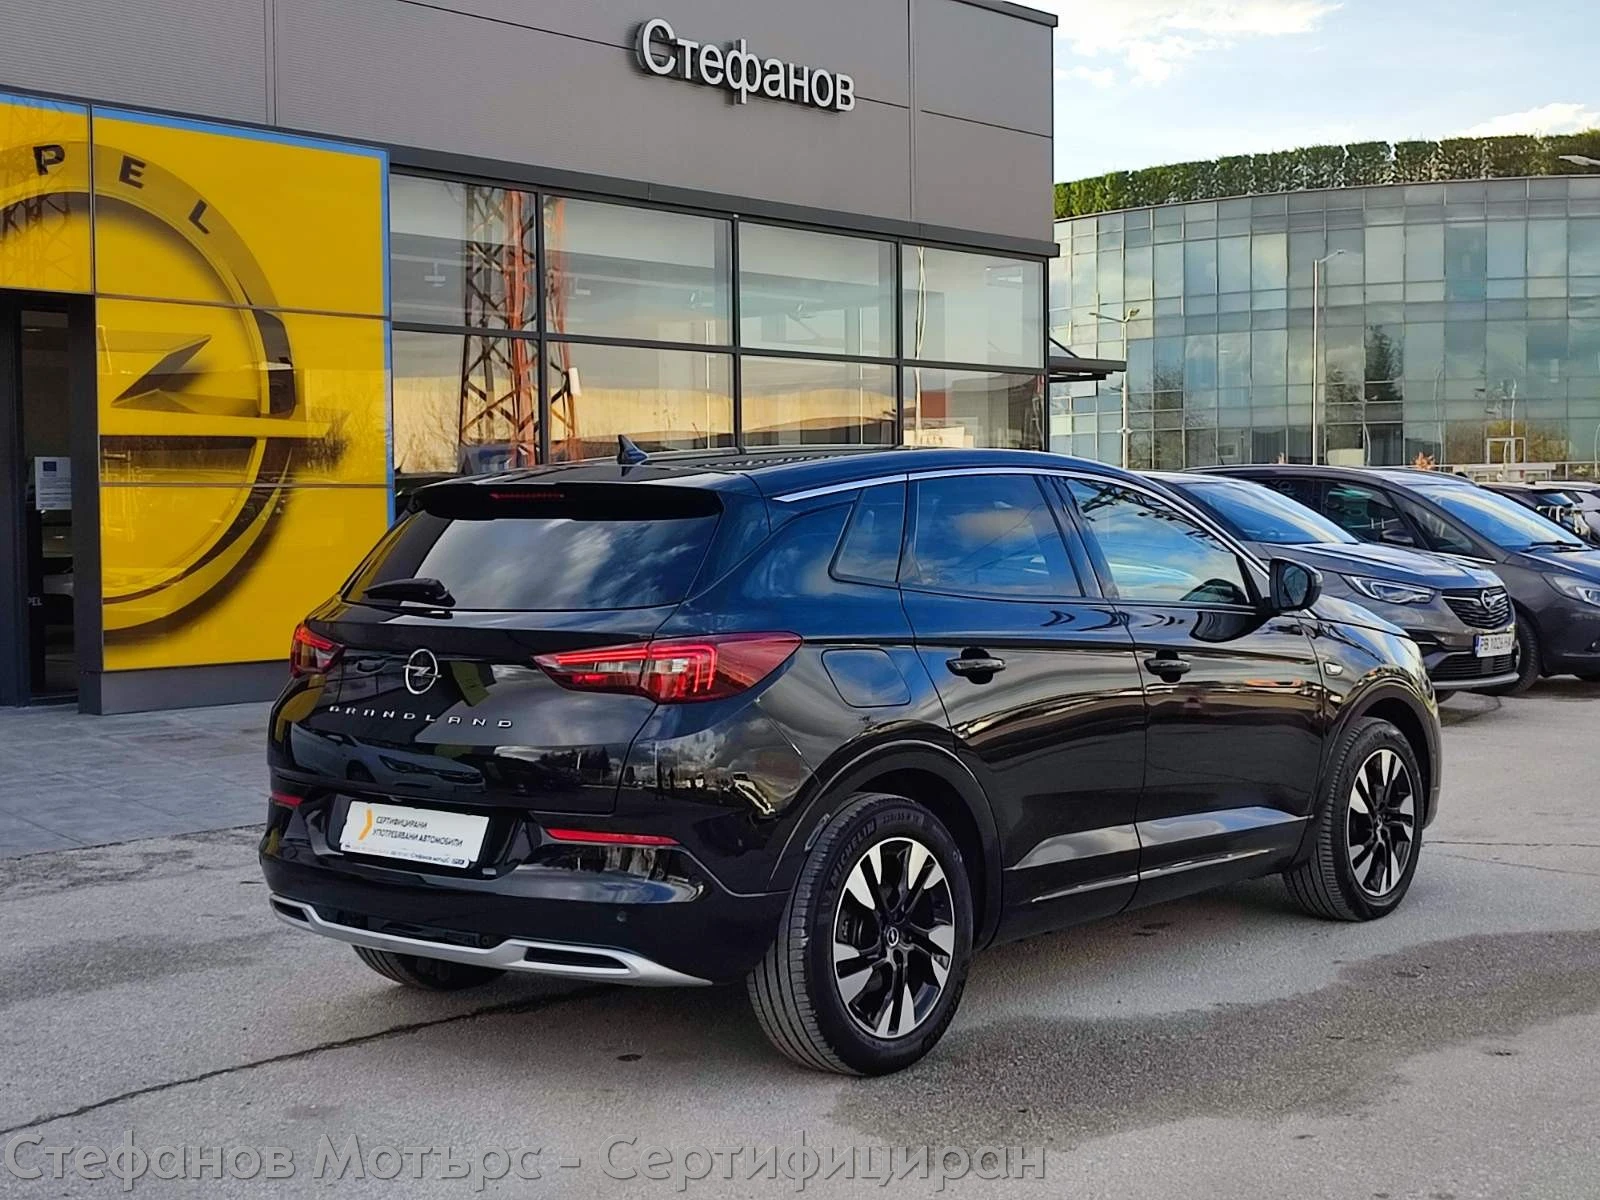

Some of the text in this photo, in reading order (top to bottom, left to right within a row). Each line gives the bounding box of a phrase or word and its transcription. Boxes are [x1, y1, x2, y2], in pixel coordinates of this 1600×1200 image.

[639, 18, 856, 111] Стефанов
[32, 144, 210, 235] PEL
[329, 705, 513, 728] GRANDLAND
[375, 815, 428, 829] СЕРТИФИЦИРАНИ
